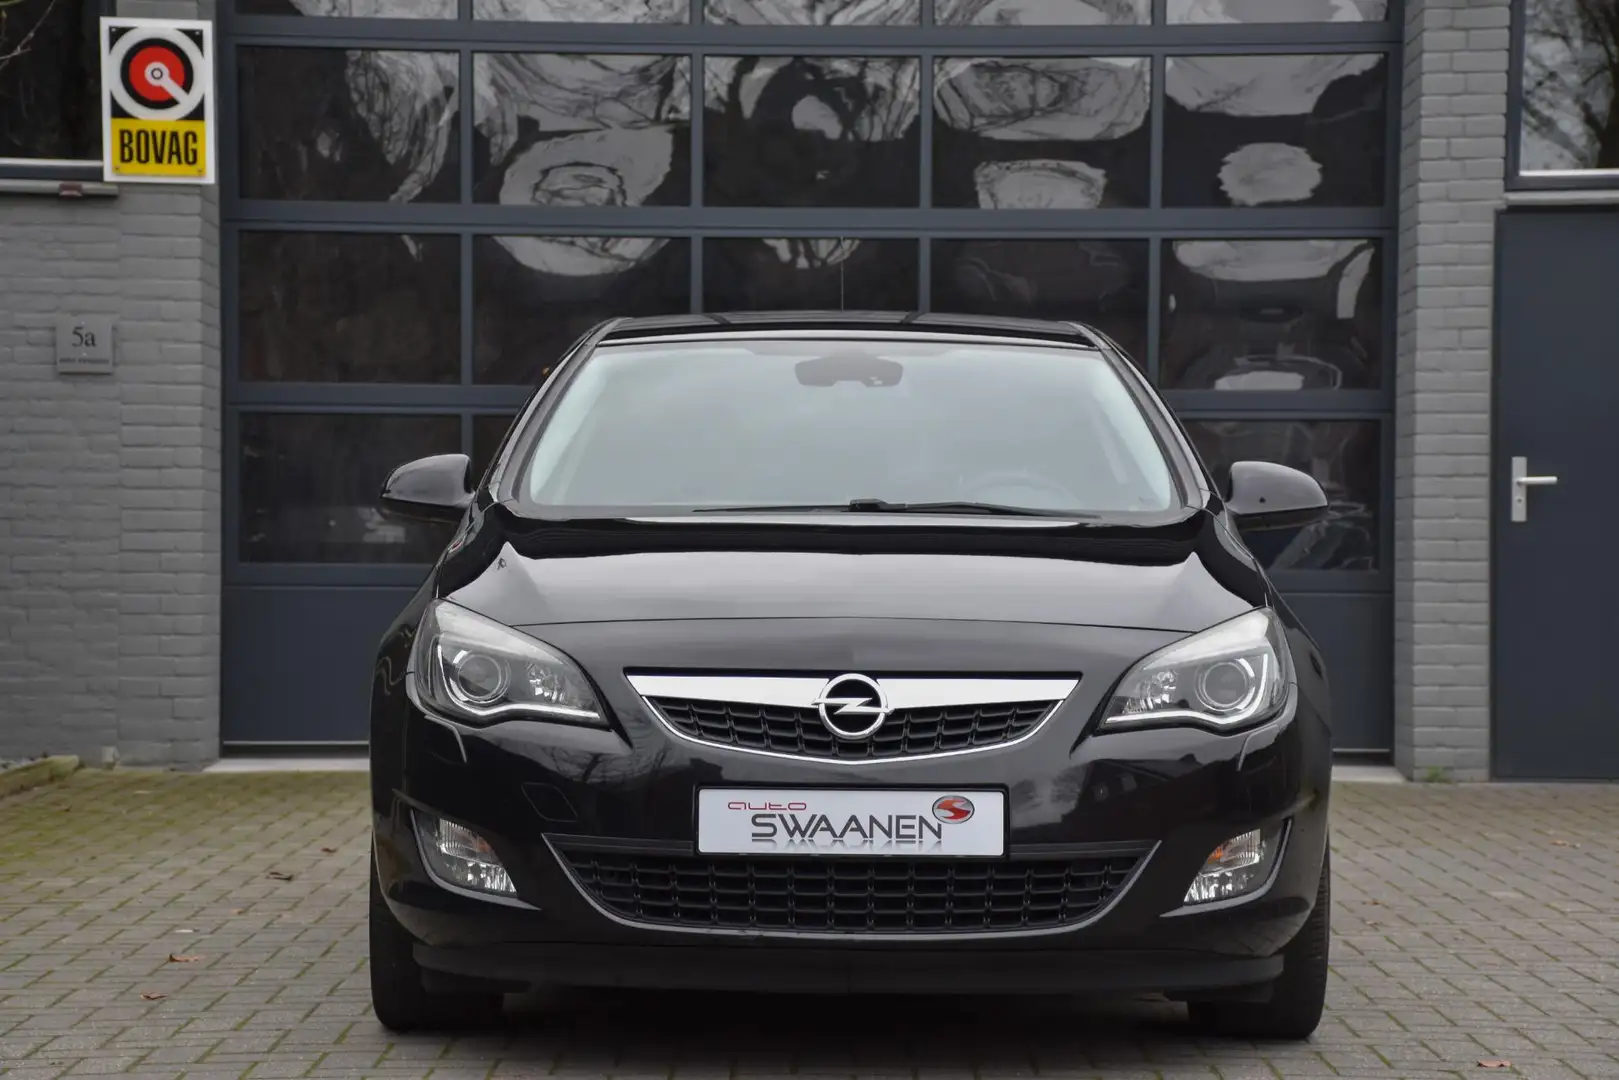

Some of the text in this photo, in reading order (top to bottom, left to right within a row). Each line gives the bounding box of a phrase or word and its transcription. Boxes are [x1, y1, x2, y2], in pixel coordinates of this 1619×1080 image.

[119, 129, 198, 165] BOVAG
[71, 326, 97, 348] 5a
[727, 801, 808, 811] auto
[751, 813, 942, 840] SWAANEN
